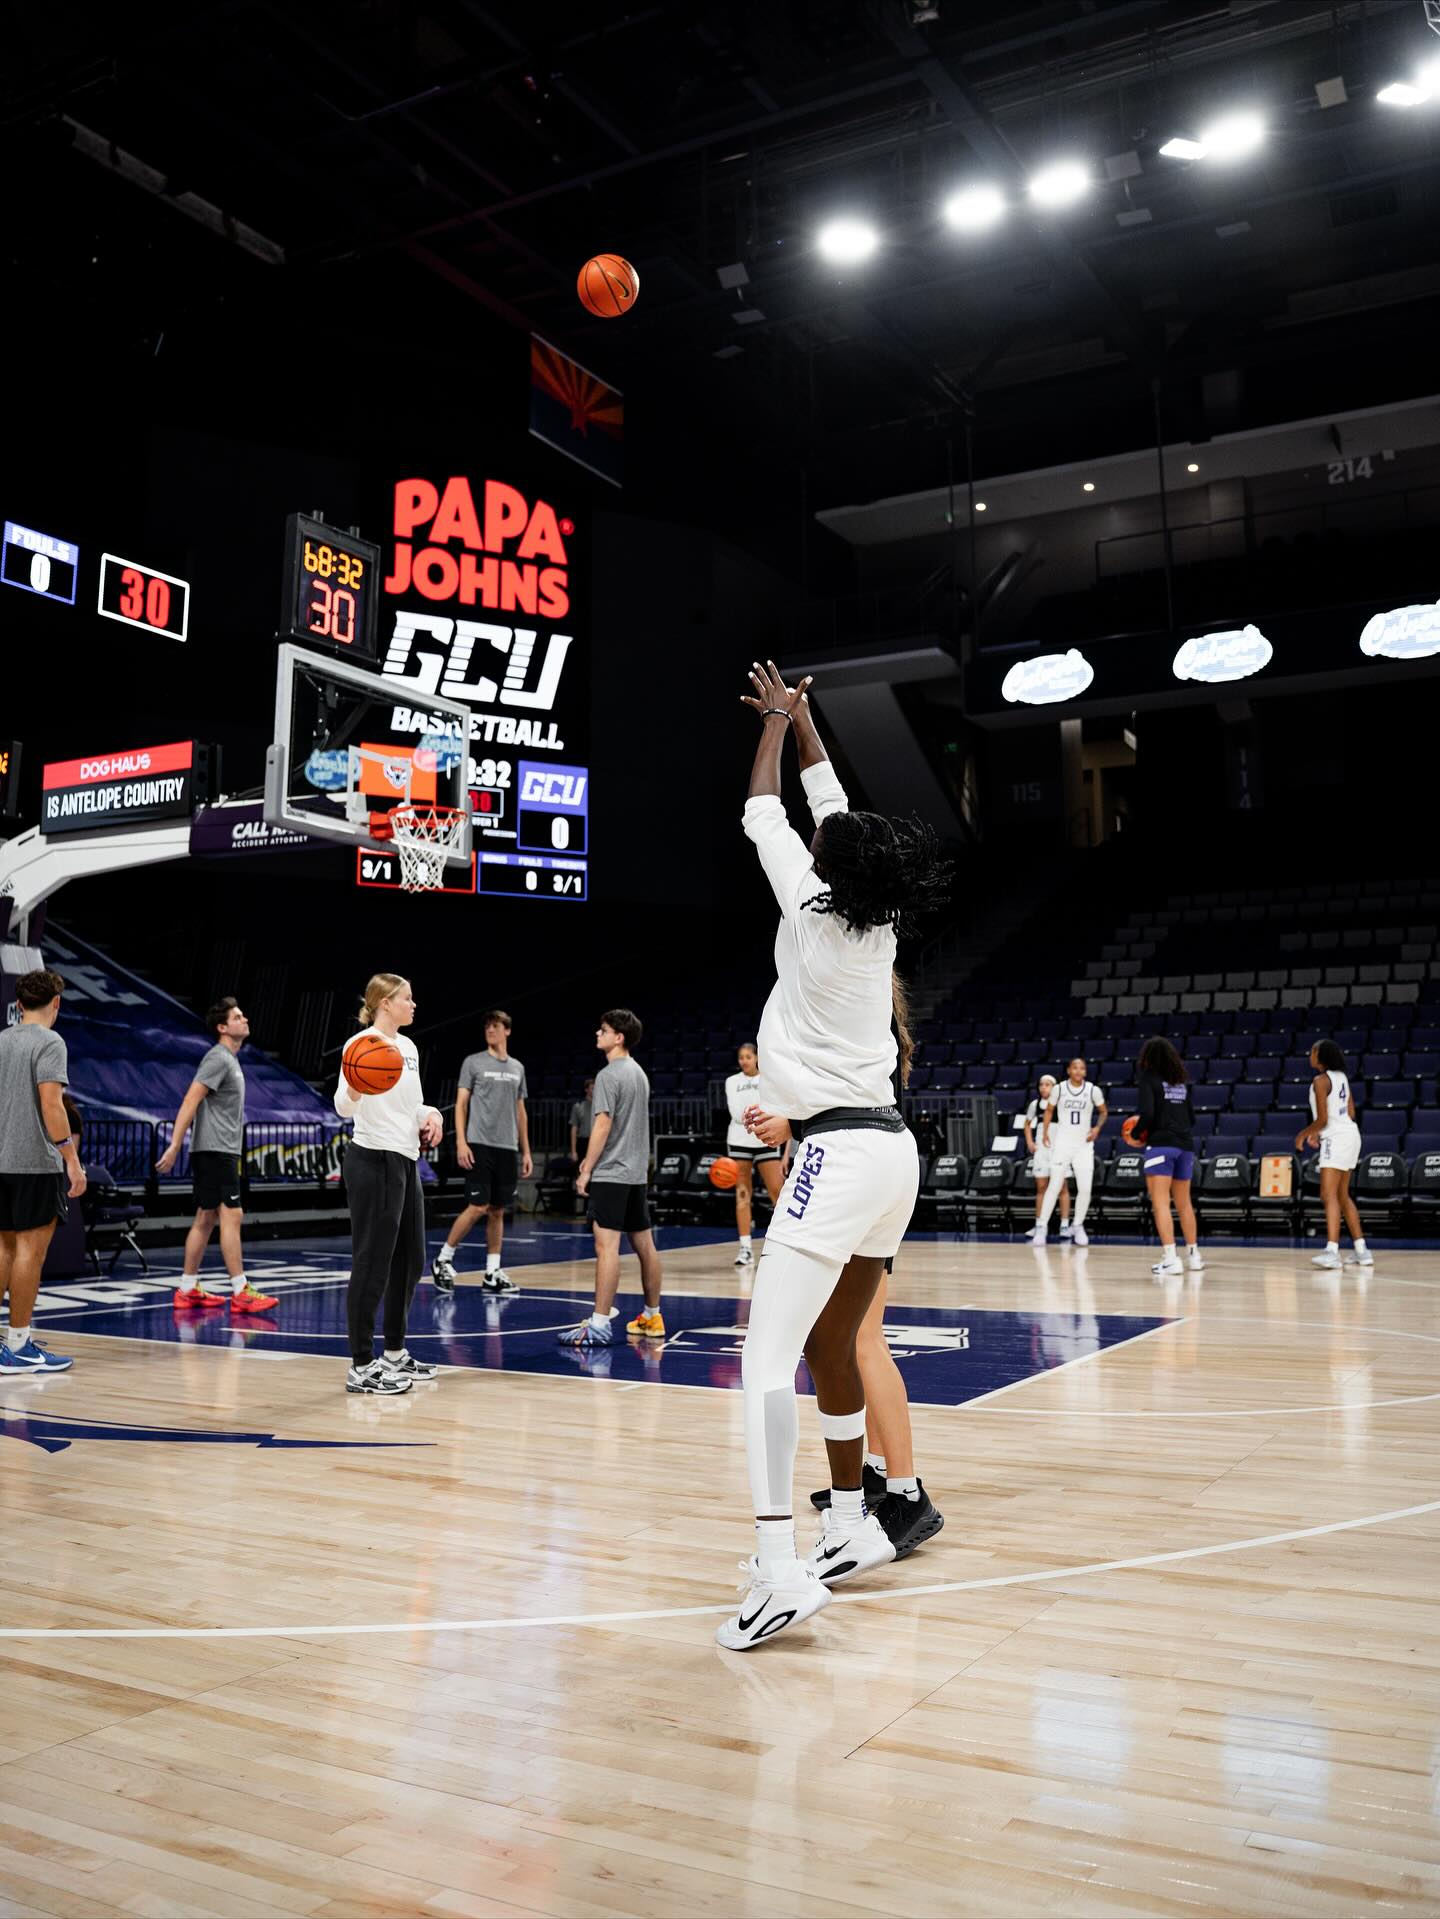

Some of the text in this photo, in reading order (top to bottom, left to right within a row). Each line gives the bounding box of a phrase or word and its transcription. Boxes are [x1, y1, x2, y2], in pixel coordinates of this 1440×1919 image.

[1327, 456, 1374, 485] 214
[12, 526, 70, 561] FOULS
[30, 552, 51, 593] 0
[303, 541, 364, 590] 68:32
[384, 542, 570, 619] JOHNS
[119, 567, 171, 628] 30
[309, 579, 355, 644] 30
[380, 610, 574, 710] GCU
[80, 753, 151, 779] DOG HAUS
[47, 777, 184, 818] IS ANTELOPE COUNTRY
[520, 771, 587, 806] GCU
[232, 821, 269, 839] CALL
[232, 835, 308, 848] ACCIDENT ATTORNEY
[551, 816, 570, 849] 0
[362, 860, 392, 879] 3/1
[525, 870, 582, 894] 0 3/1
[1338, 1083, 1346, 1101] 4
[1071, 1111, 1080, 1125] 0
[787, 1143, 825, 1220] LOPES
